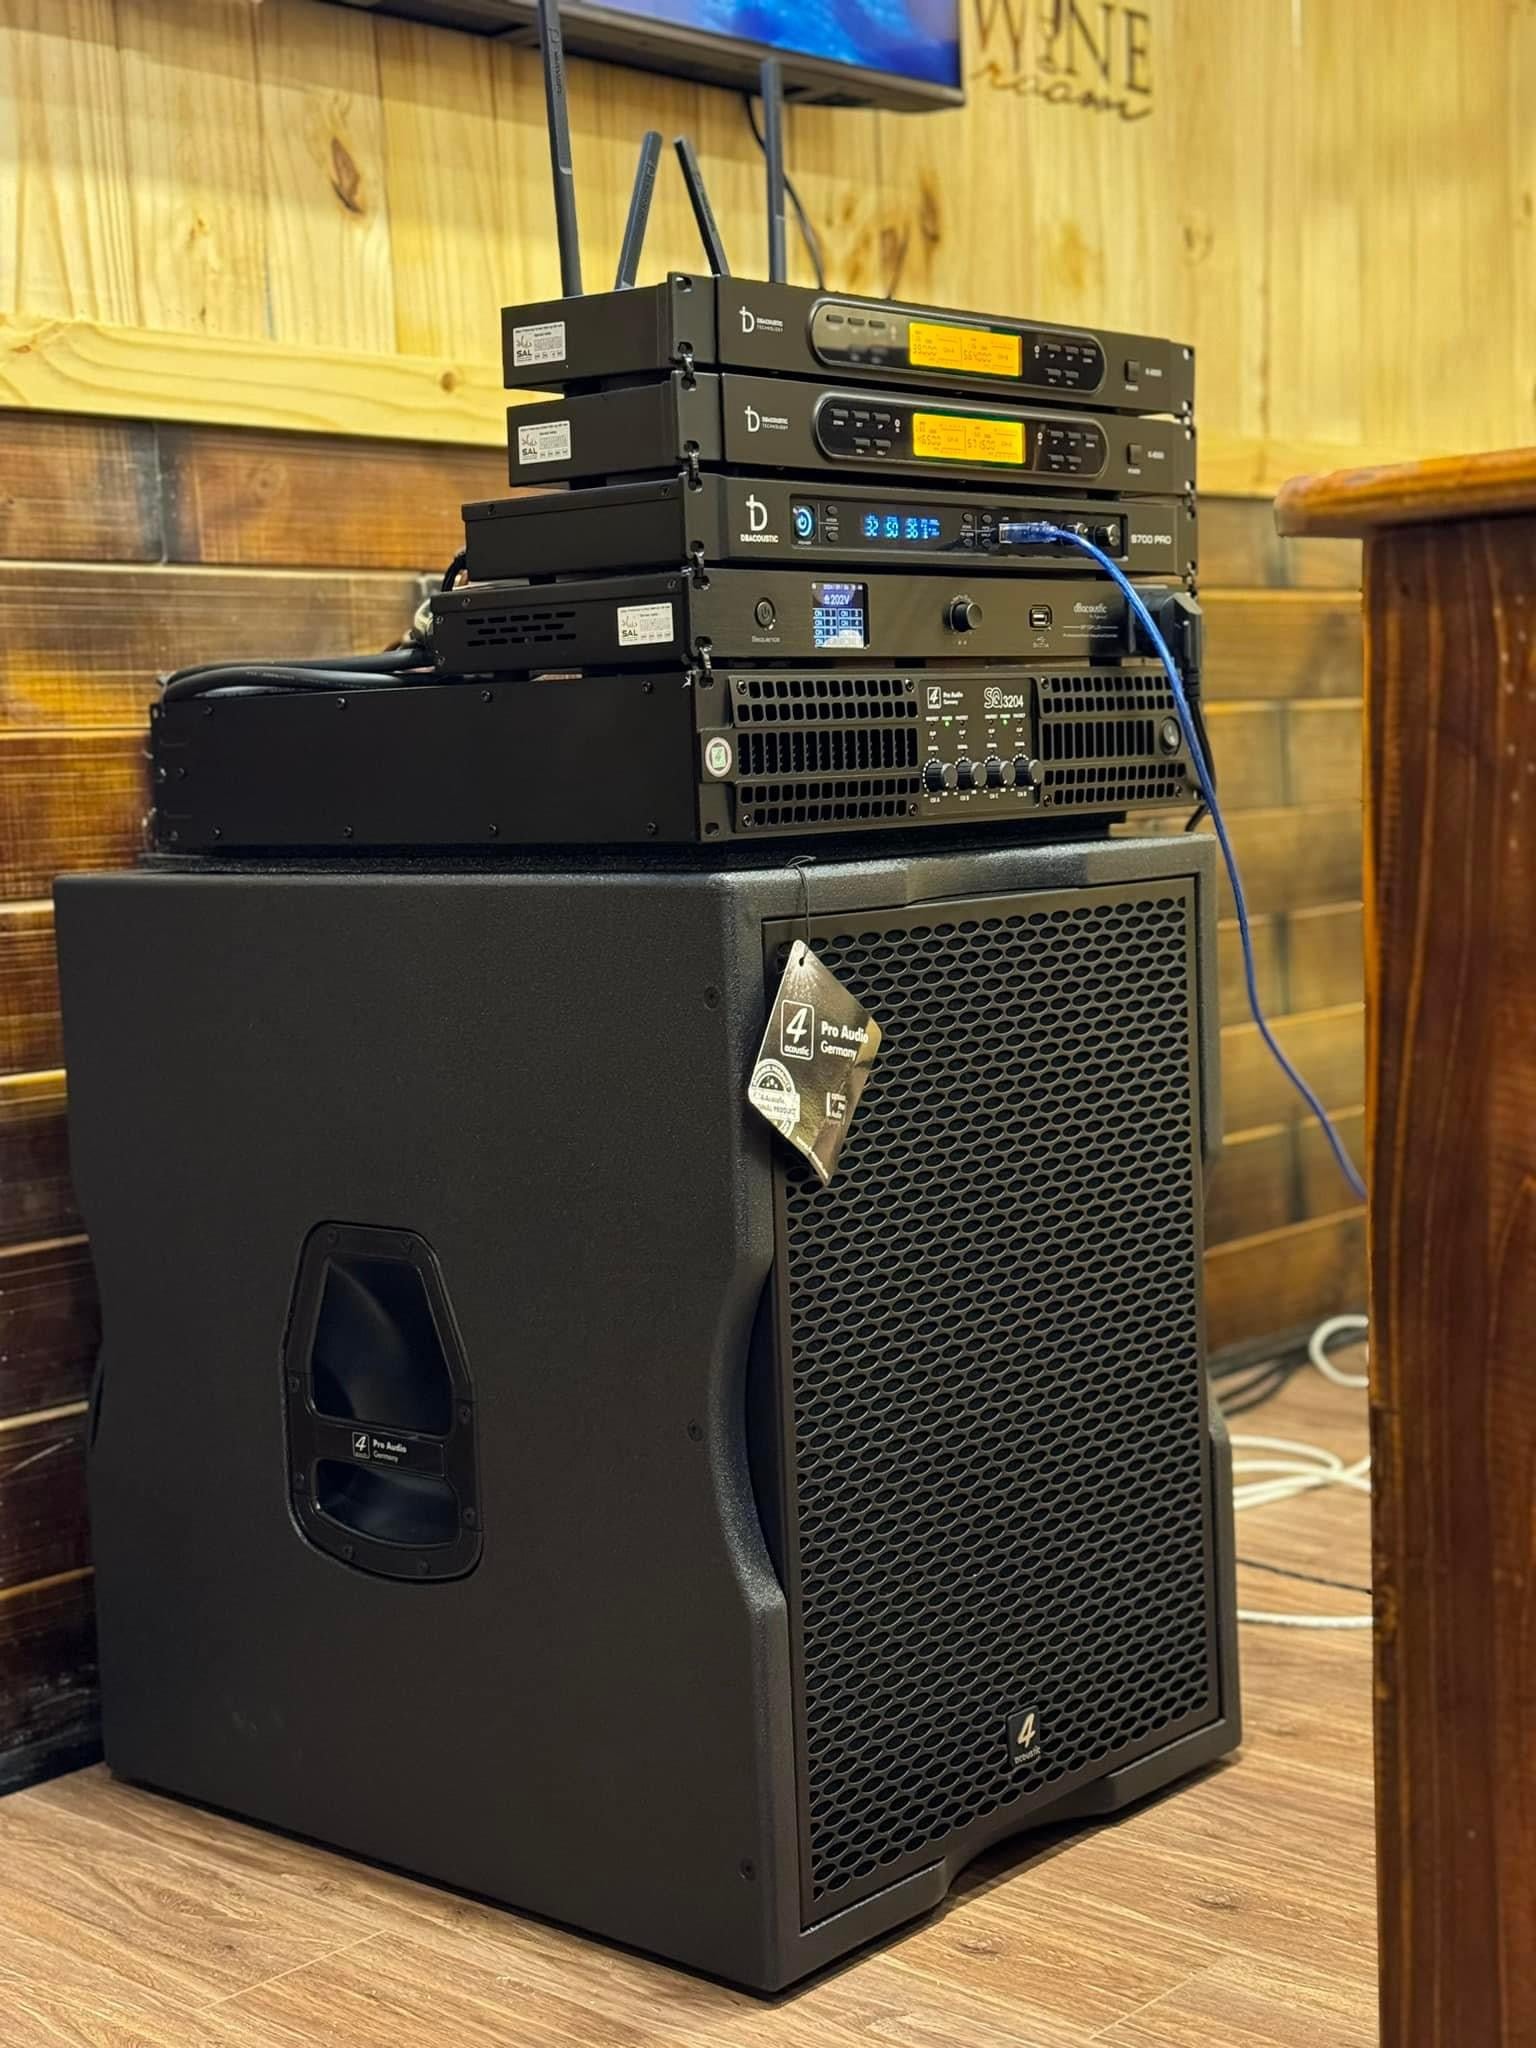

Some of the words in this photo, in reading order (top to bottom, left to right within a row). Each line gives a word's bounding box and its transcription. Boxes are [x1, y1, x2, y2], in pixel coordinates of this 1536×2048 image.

[516, 349, 532, 357] SAL
[521, 447, 538, 456] SAL
[1155, 535, 1171, 544] PRO
[621, 629, 638, 637] SAL
[786, 1008, 807, 1043] 4
[821, 1021, 839, 1037] Pro
[841, 1025, 868, 1043] Audio
[784, 1045, 810, 1056] acoustic
[821, 1041, 857, 1061] Germany
[355, 1436, 366, 1451] 4
[373, 1439, 385, 1449] Pro
[387, 1441, 407, 1453] Audio
[1016, 1712, 1037, 1749] 4
